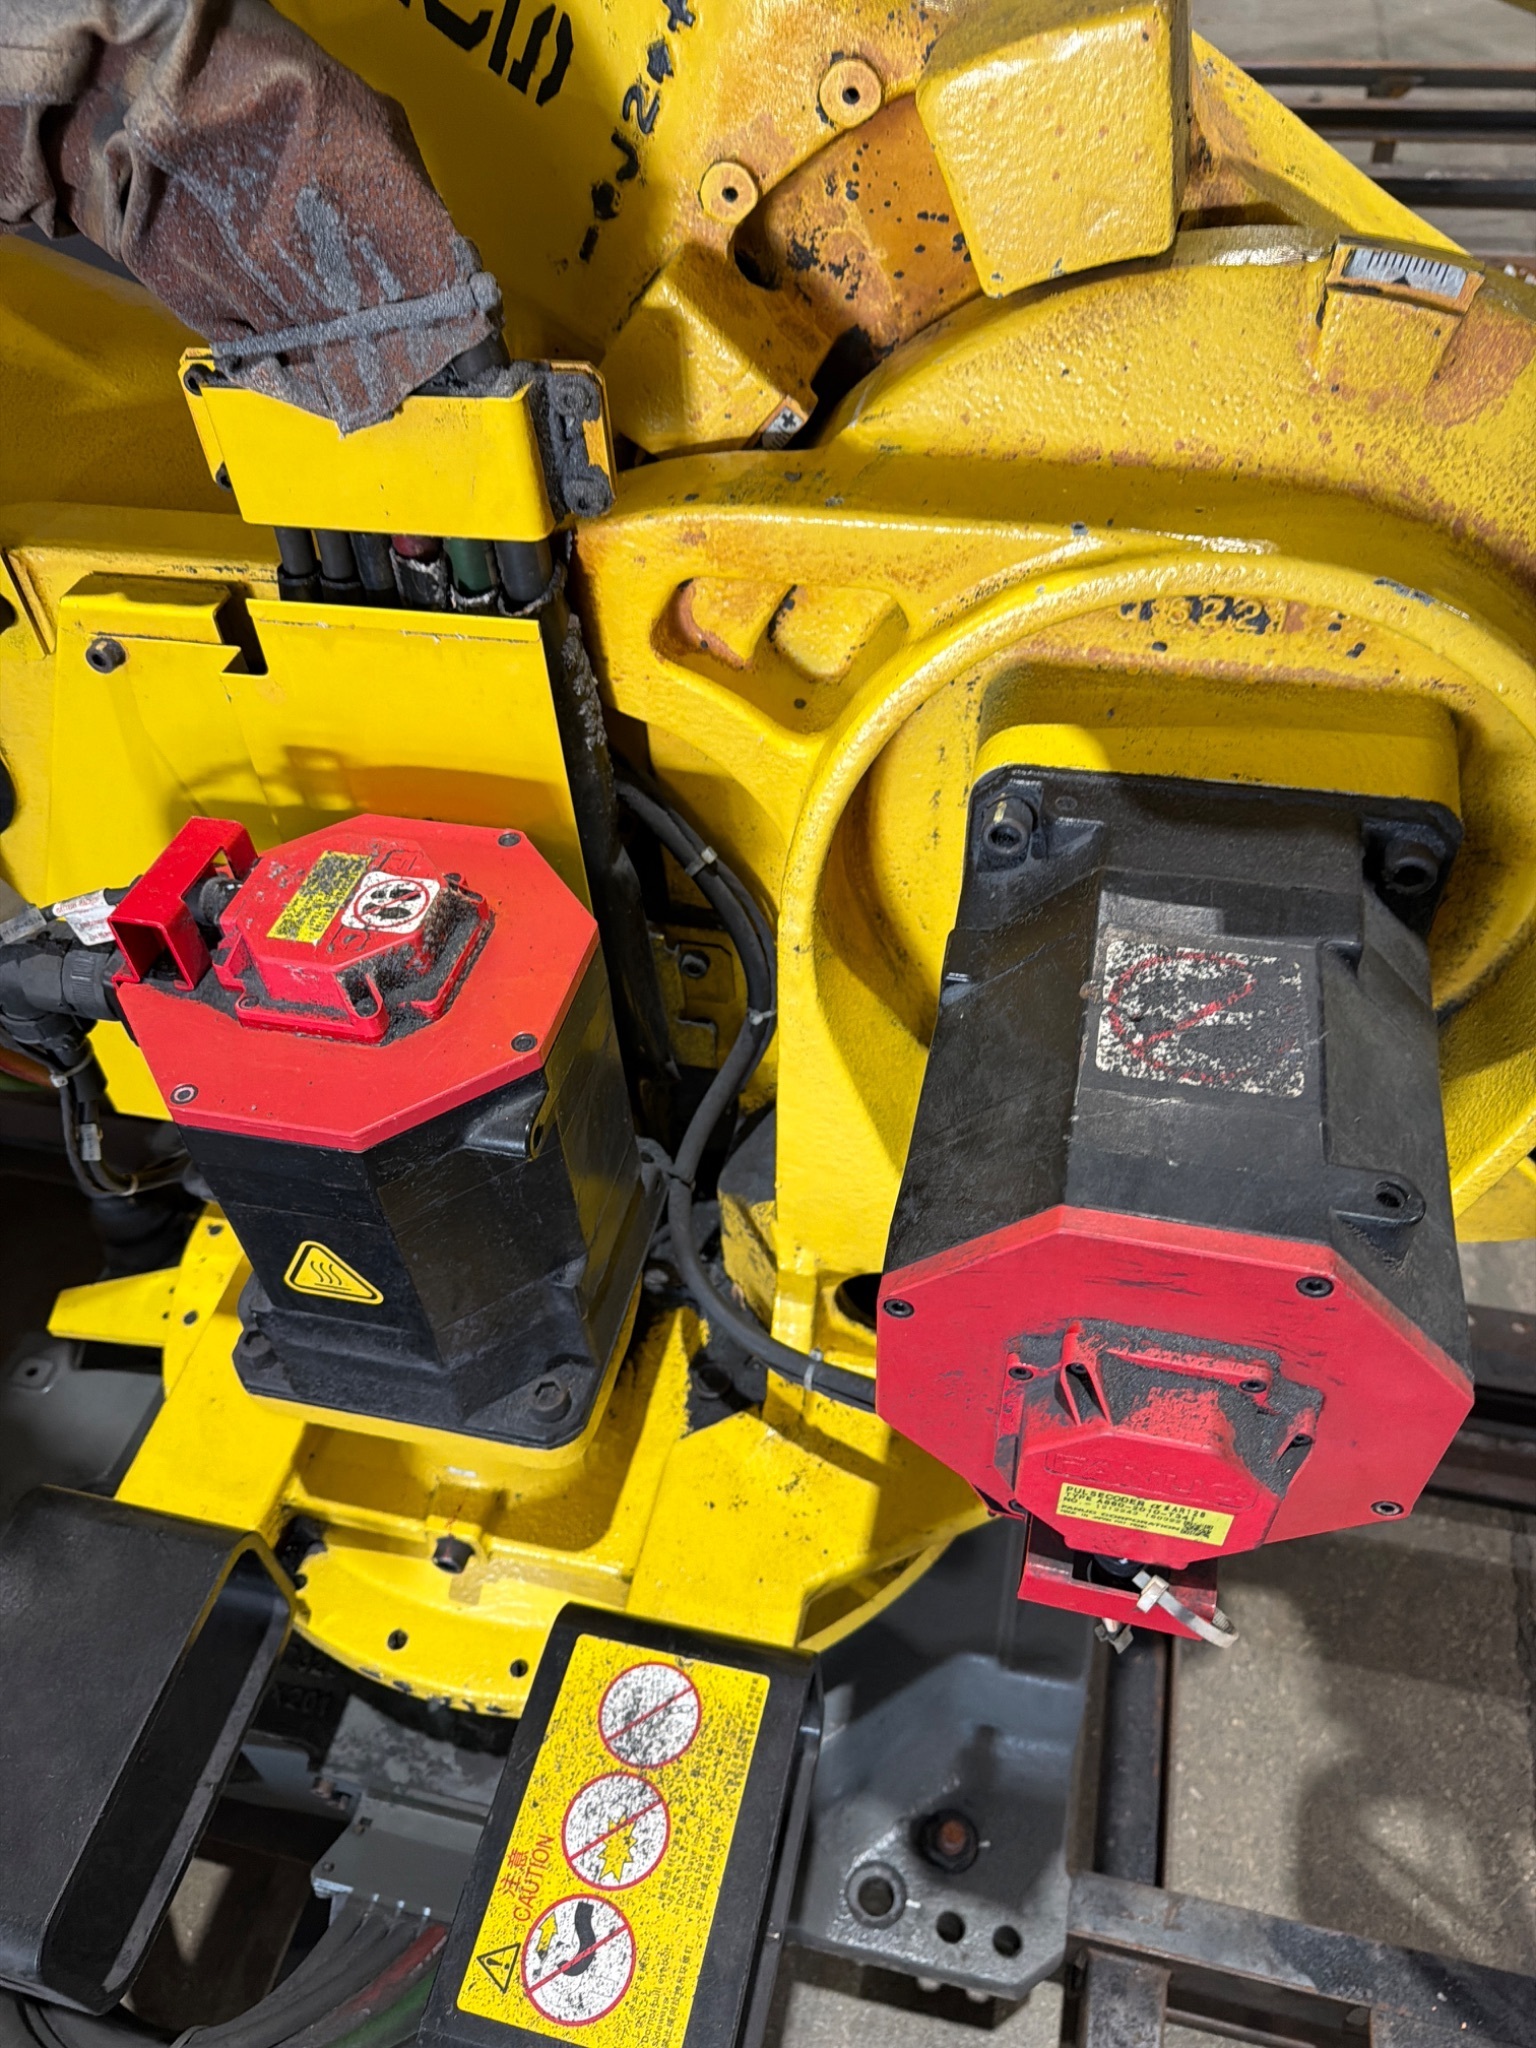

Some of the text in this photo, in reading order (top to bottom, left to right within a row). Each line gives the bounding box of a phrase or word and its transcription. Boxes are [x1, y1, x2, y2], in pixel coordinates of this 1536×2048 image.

[1066, 1486, 1145, 1506] PULSECODER
[497, 1846, 530, 1898] 注意
[512, 1833, 555, 1922] CAUTION
